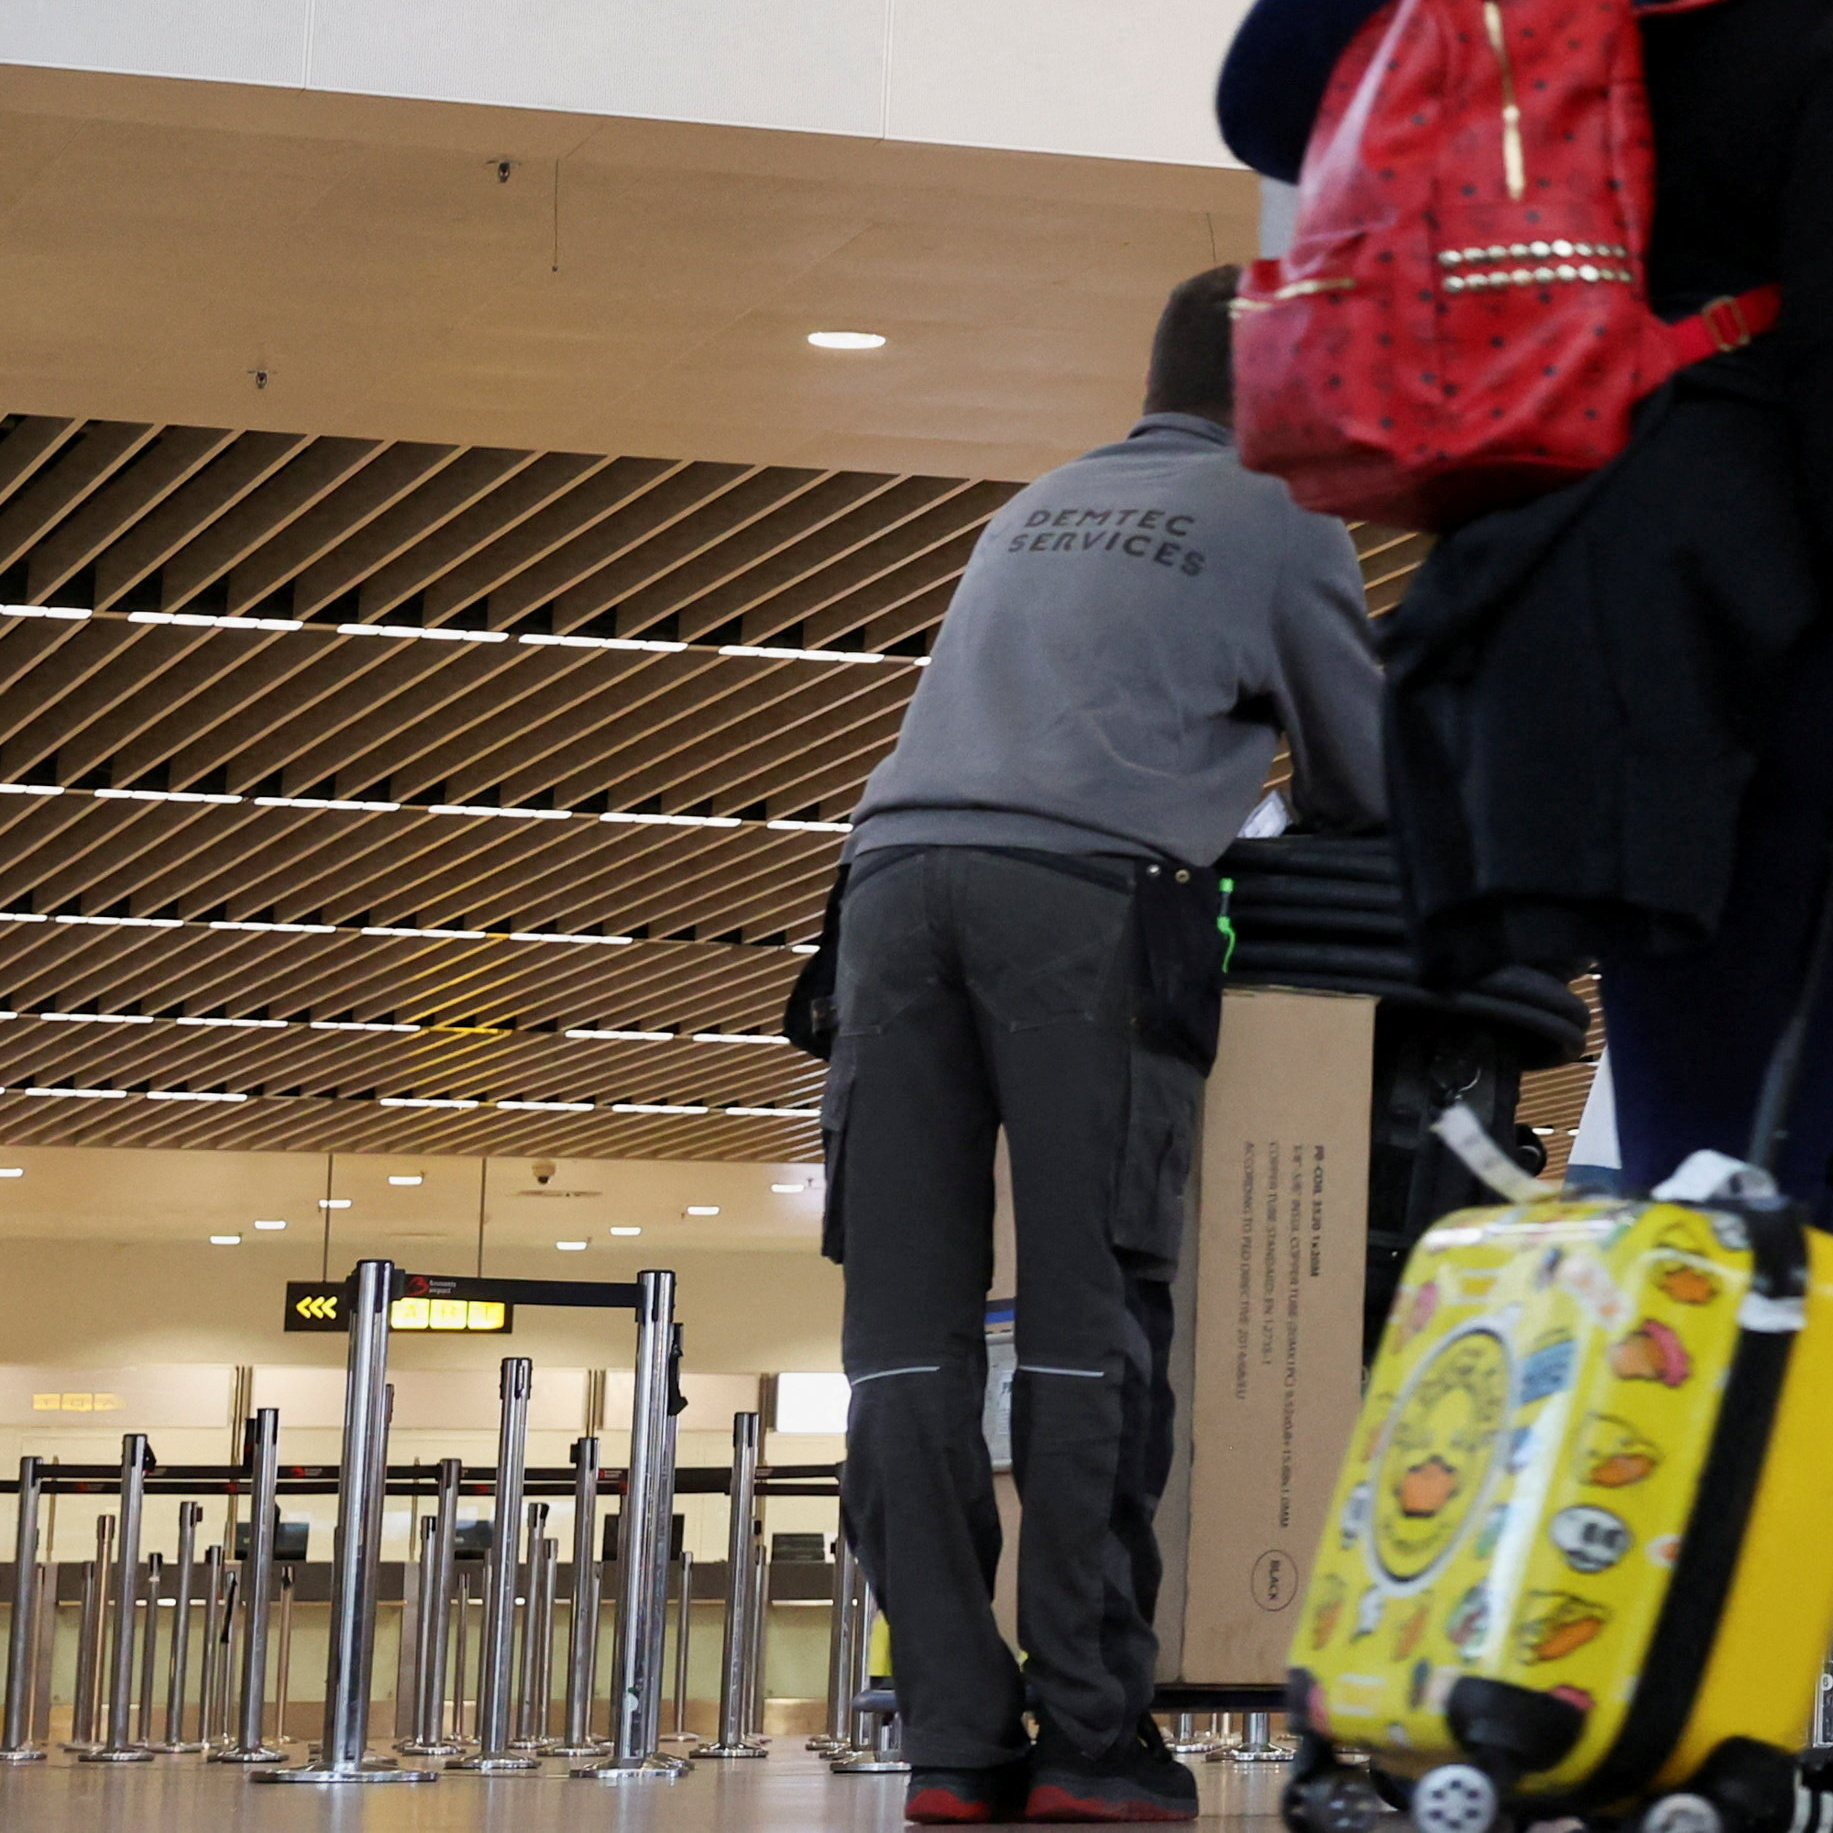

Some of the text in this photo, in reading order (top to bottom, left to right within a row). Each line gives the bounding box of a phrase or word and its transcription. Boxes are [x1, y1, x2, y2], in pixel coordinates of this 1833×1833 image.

[1025, 508, 1195, 537] DEMTEC
[1008, 531, 1206, 577] SERVICES
[1267, 1559, 1281, 1601] BLACK
